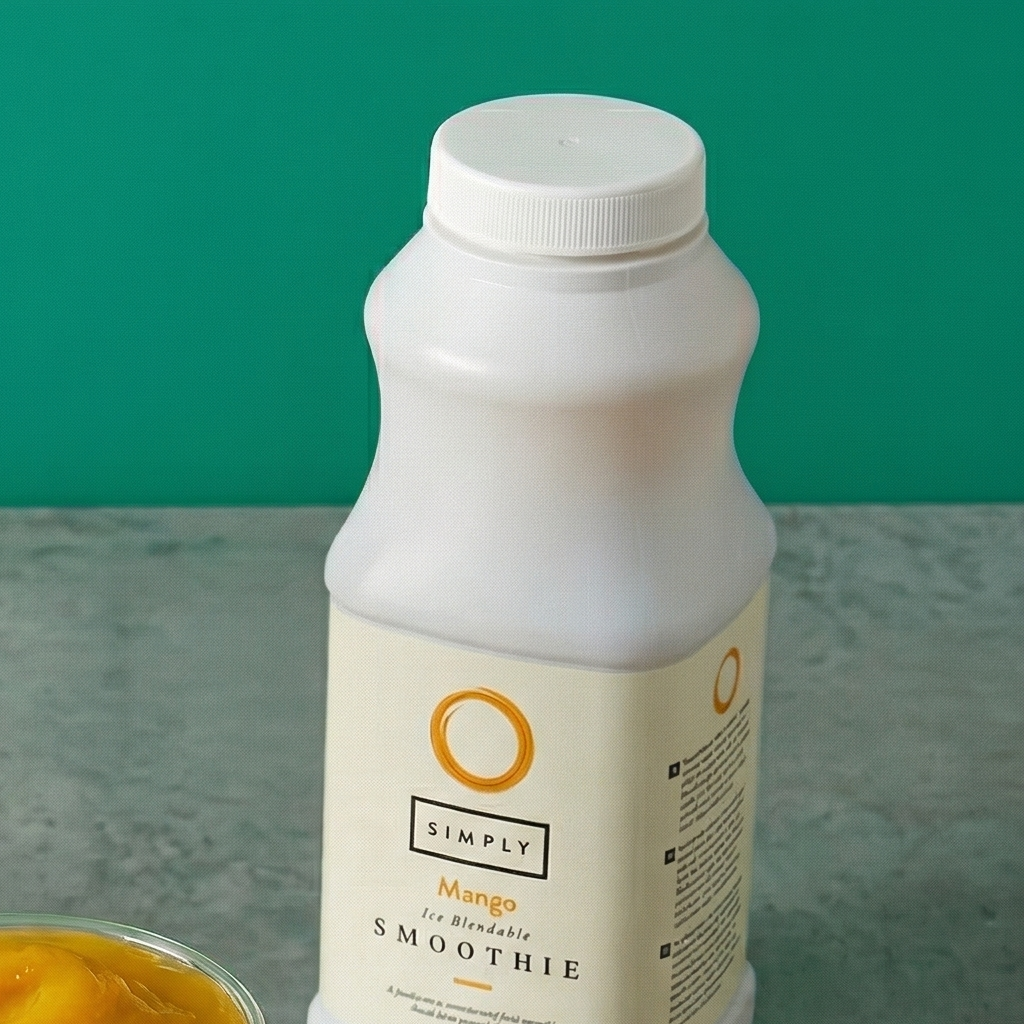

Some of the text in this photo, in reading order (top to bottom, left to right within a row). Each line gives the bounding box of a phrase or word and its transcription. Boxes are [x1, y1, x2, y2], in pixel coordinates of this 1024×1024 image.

[428, 822, 530, 855] SIMPLY
[438, 876, 517, 917] Mango
[421, 907, 531, 941] Ice Blendable
[374, 918, 580, 980] SMOOTHIE
